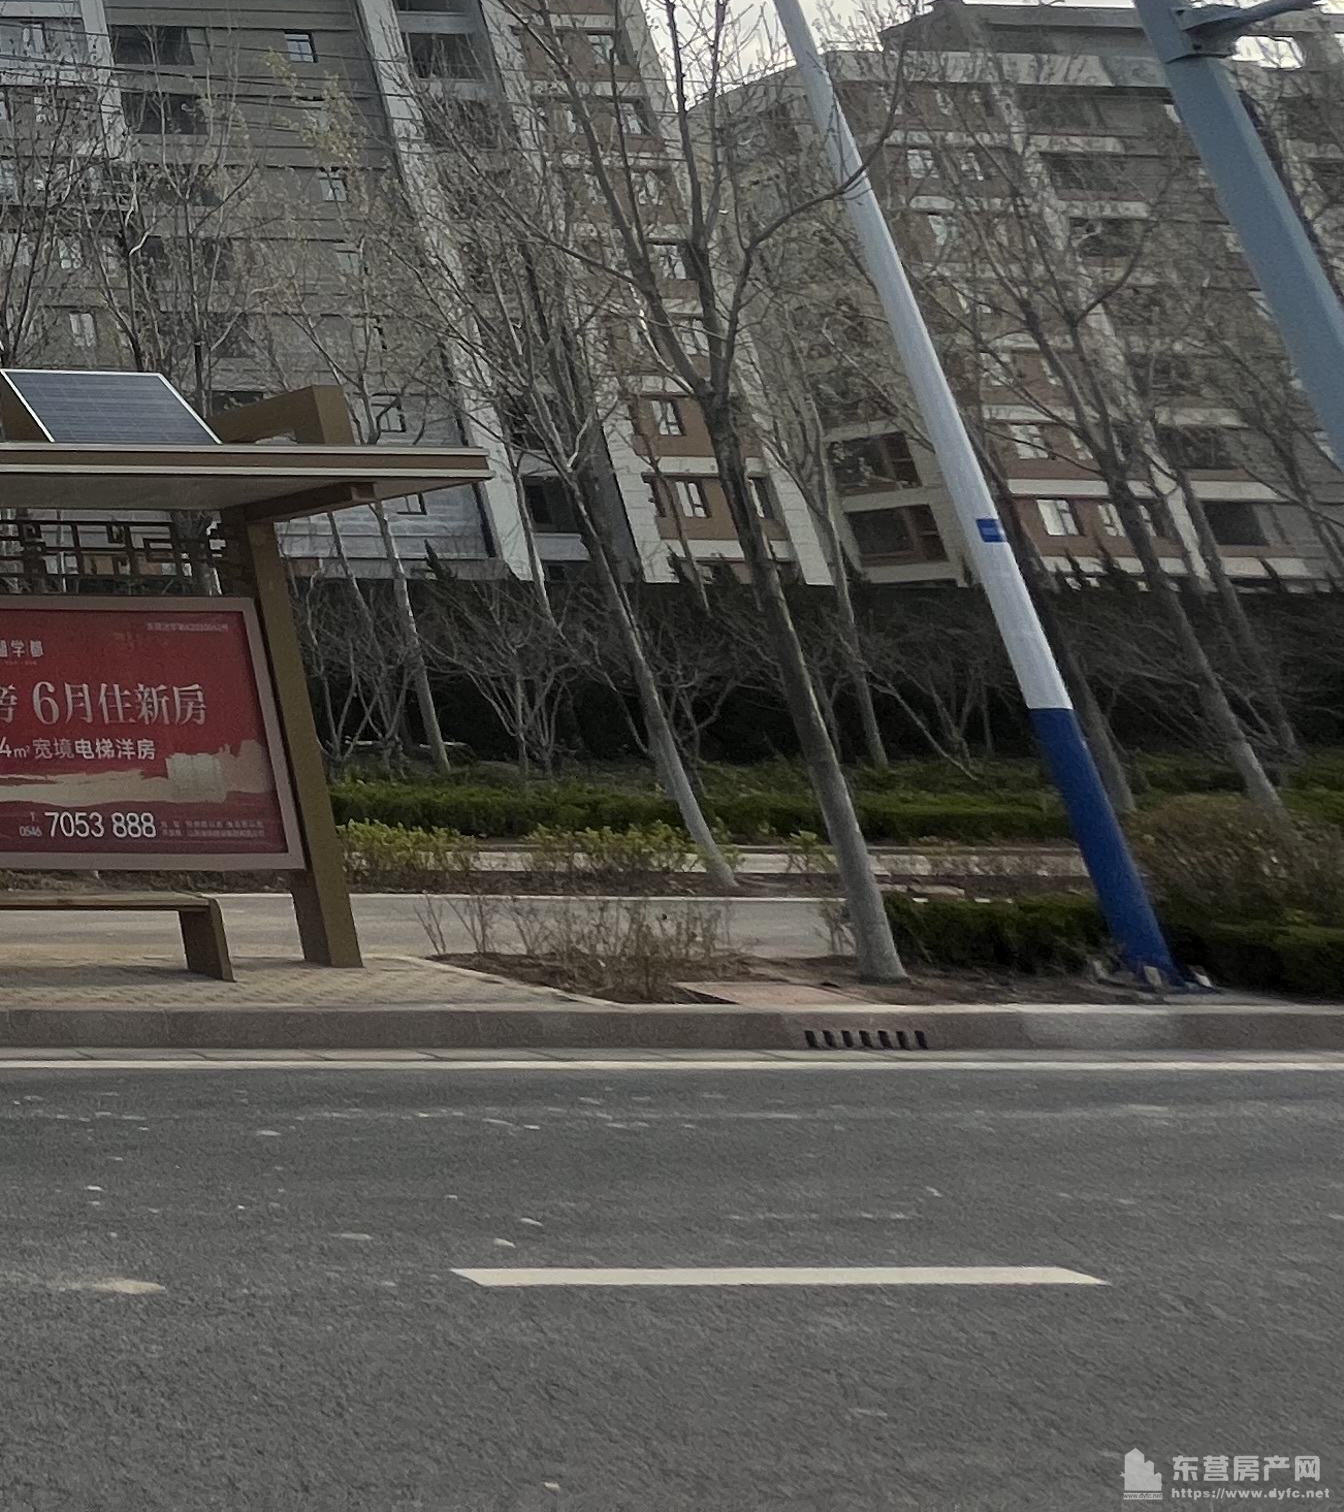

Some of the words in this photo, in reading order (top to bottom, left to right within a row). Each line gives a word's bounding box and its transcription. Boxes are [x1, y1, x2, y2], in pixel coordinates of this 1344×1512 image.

[32, 681, 207, 726] 6月住新房
[32, 738, 156, 760] 宽境电梯洋房
[44, 811, 105, 838] 7053
[110, 811, 157, 838] 888
